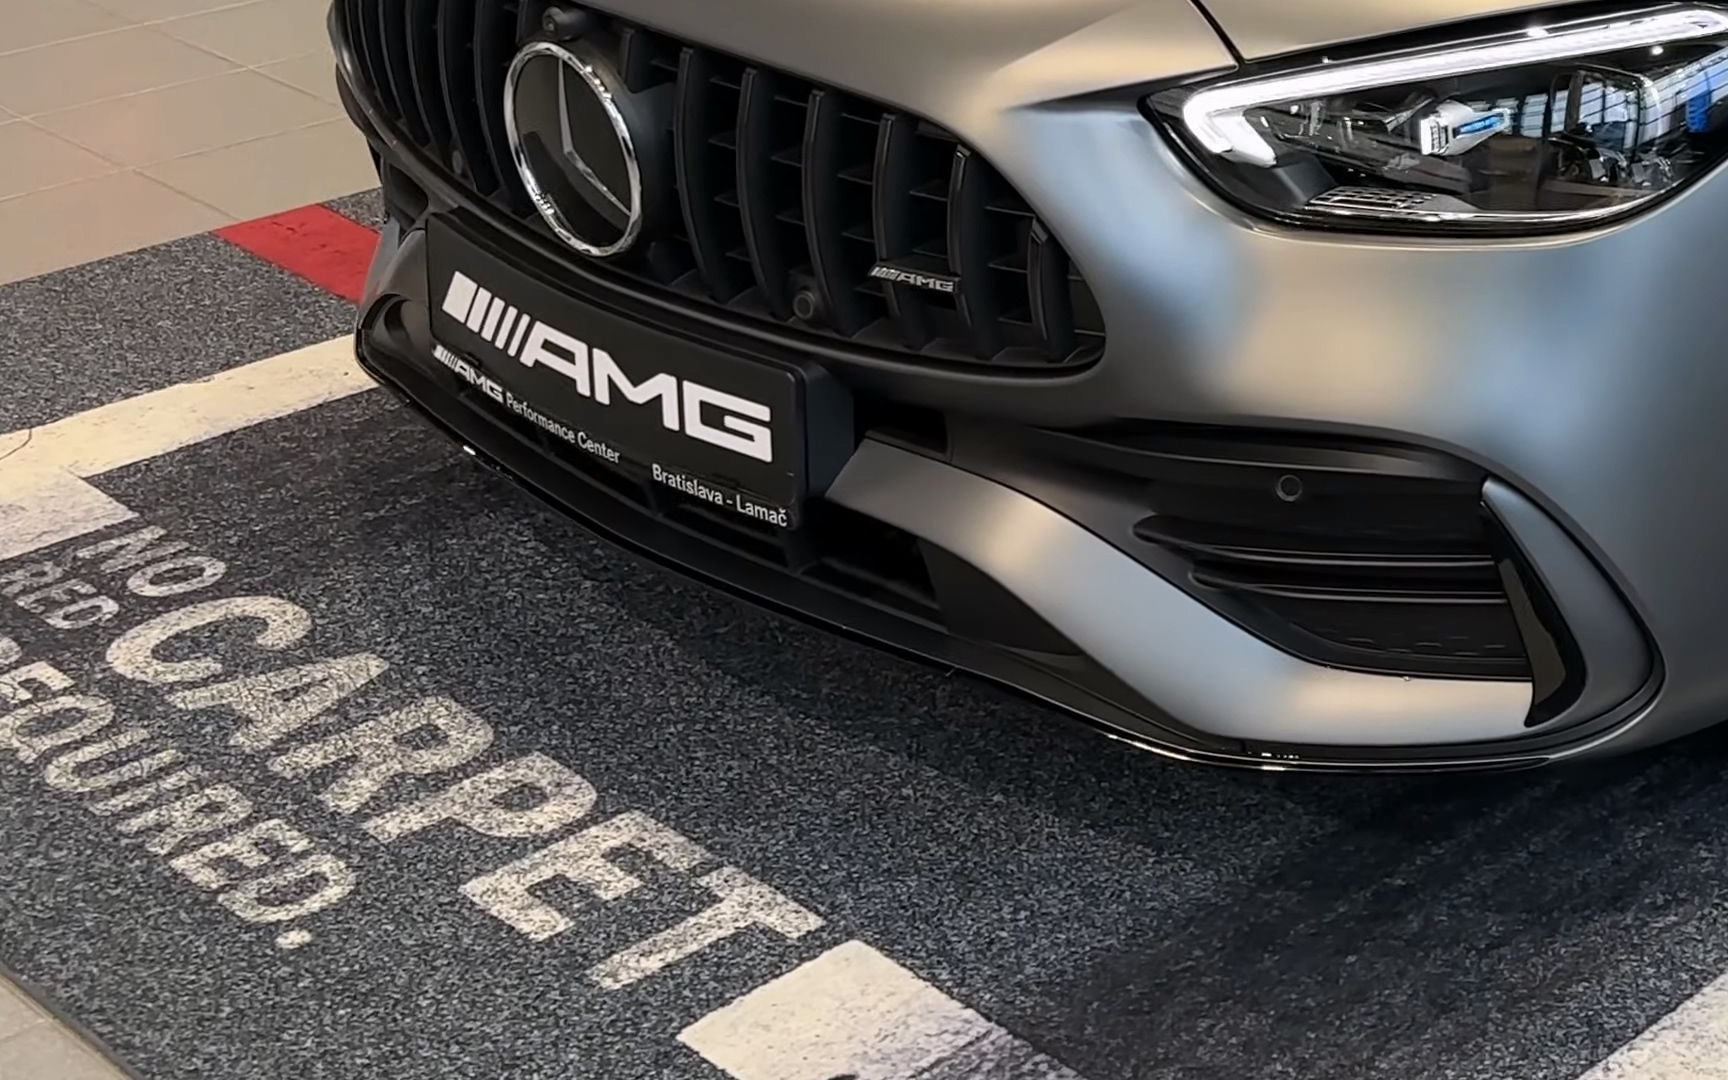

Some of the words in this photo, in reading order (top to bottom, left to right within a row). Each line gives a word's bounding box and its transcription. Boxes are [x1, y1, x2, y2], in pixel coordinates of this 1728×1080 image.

[895, 271, 955, 293] AMG
[453, 358, 505, 404] AMG
[506, 391, 577, 446] Performance
[576, 432, 621, 465] Center
[518, 320, 774, 464] AMG
[651, 463, 724, 507] Bratislava
[736, 494, 788, 528] Lamač
[0, 560, 120, 630] RED
[75, 525, 228, 598] NO
[105, 595, 823, 991] CARPET
